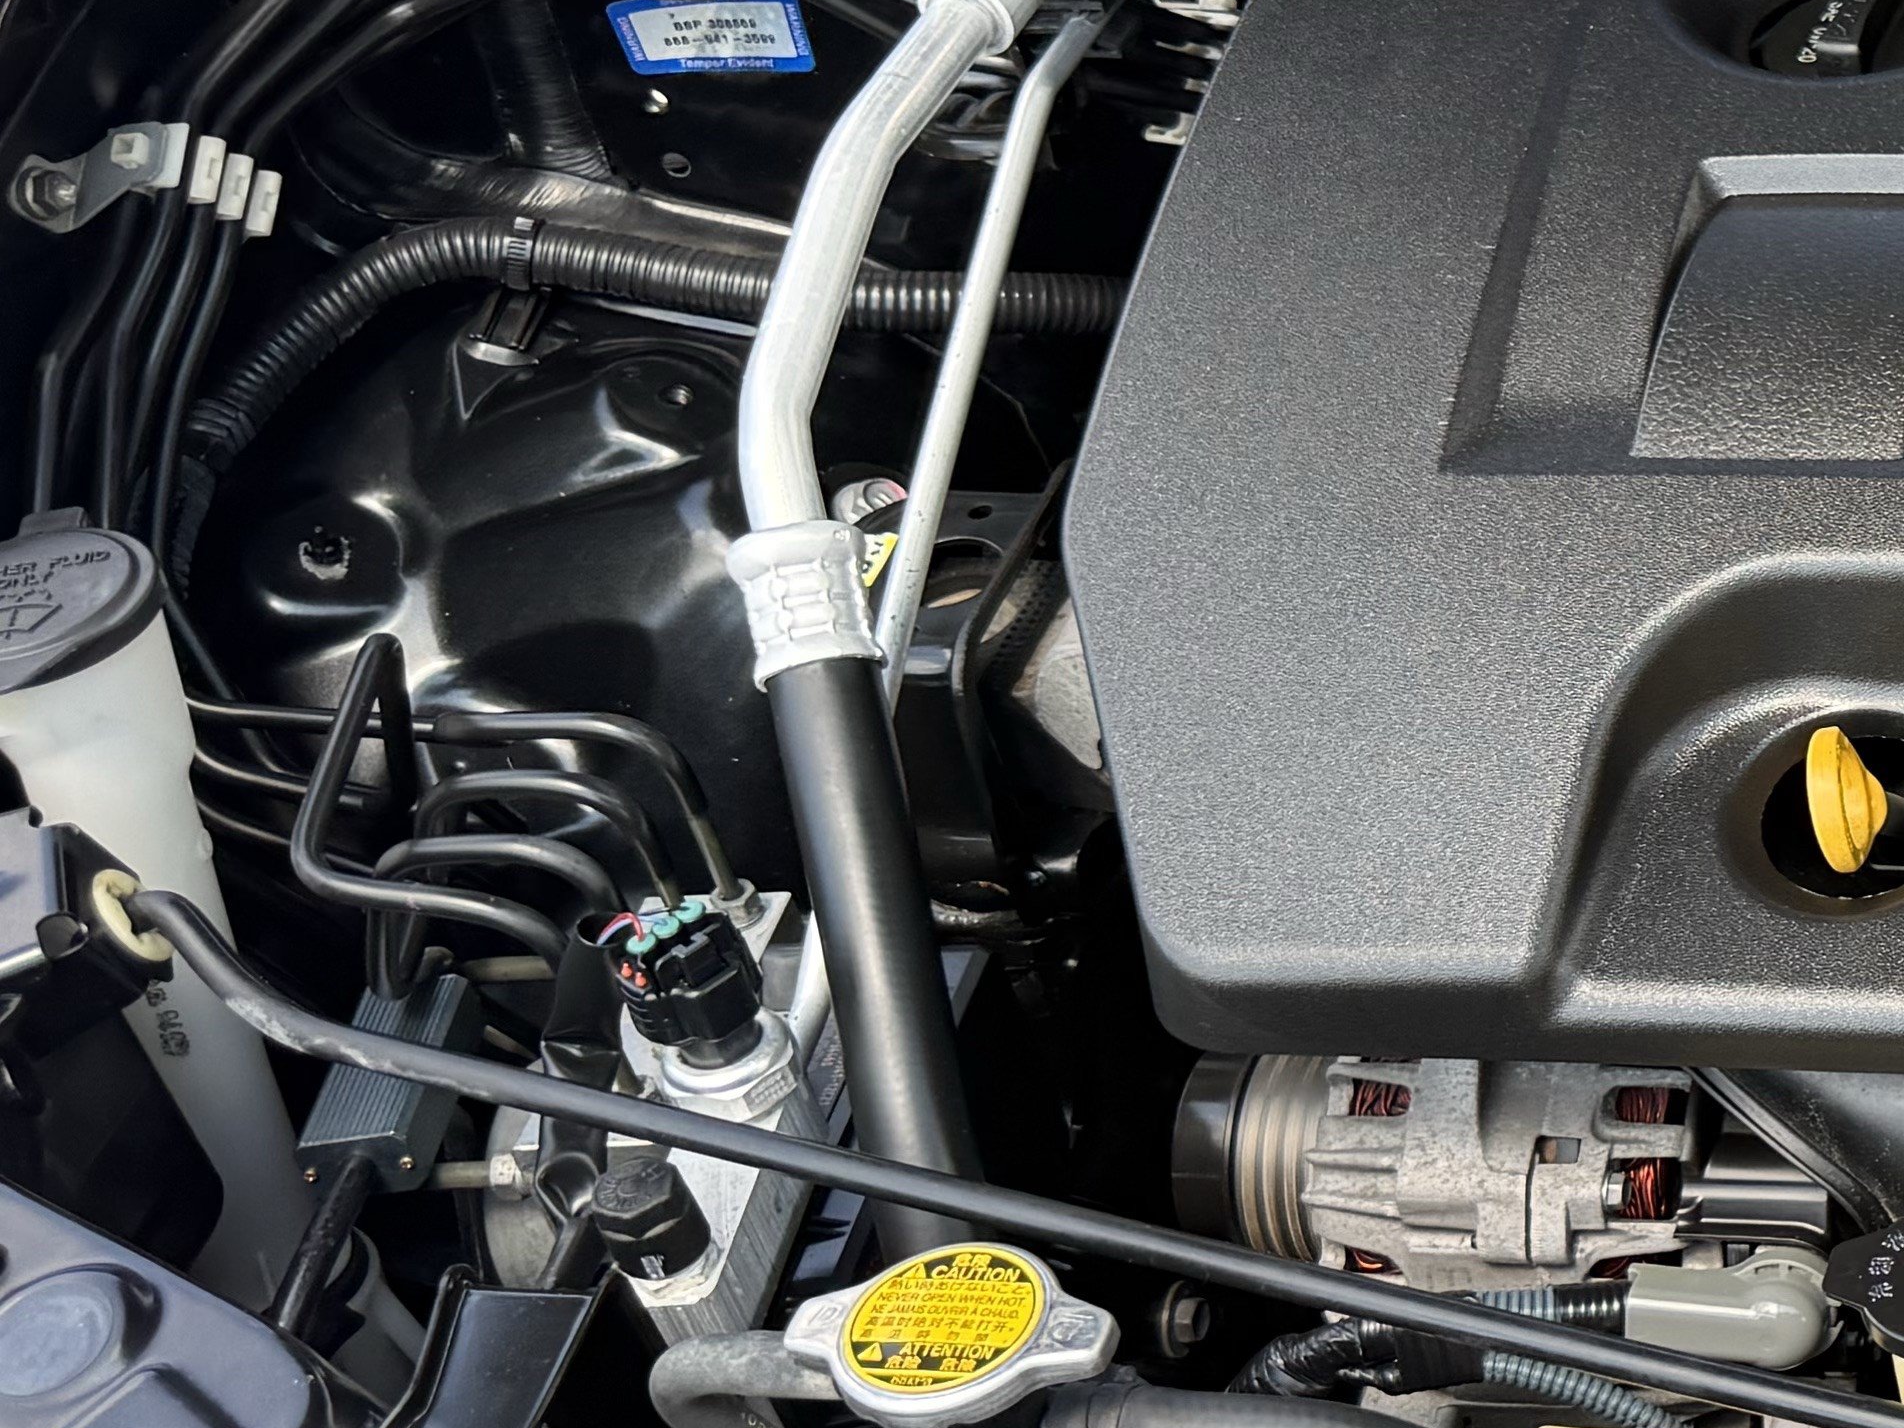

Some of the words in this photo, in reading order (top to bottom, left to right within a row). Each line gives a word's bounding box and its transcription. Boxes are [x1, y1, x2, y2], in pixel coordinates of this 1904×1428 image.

[930, 1265, 1021, 1283] CAUTION
[876, 1291, 921, 1303] NEVER
[921, 1292, 956, 1303] OPEN
[959, 1294, 997, 1305] WHEN
[898, 1341, 996, 1360] ATTENTION
